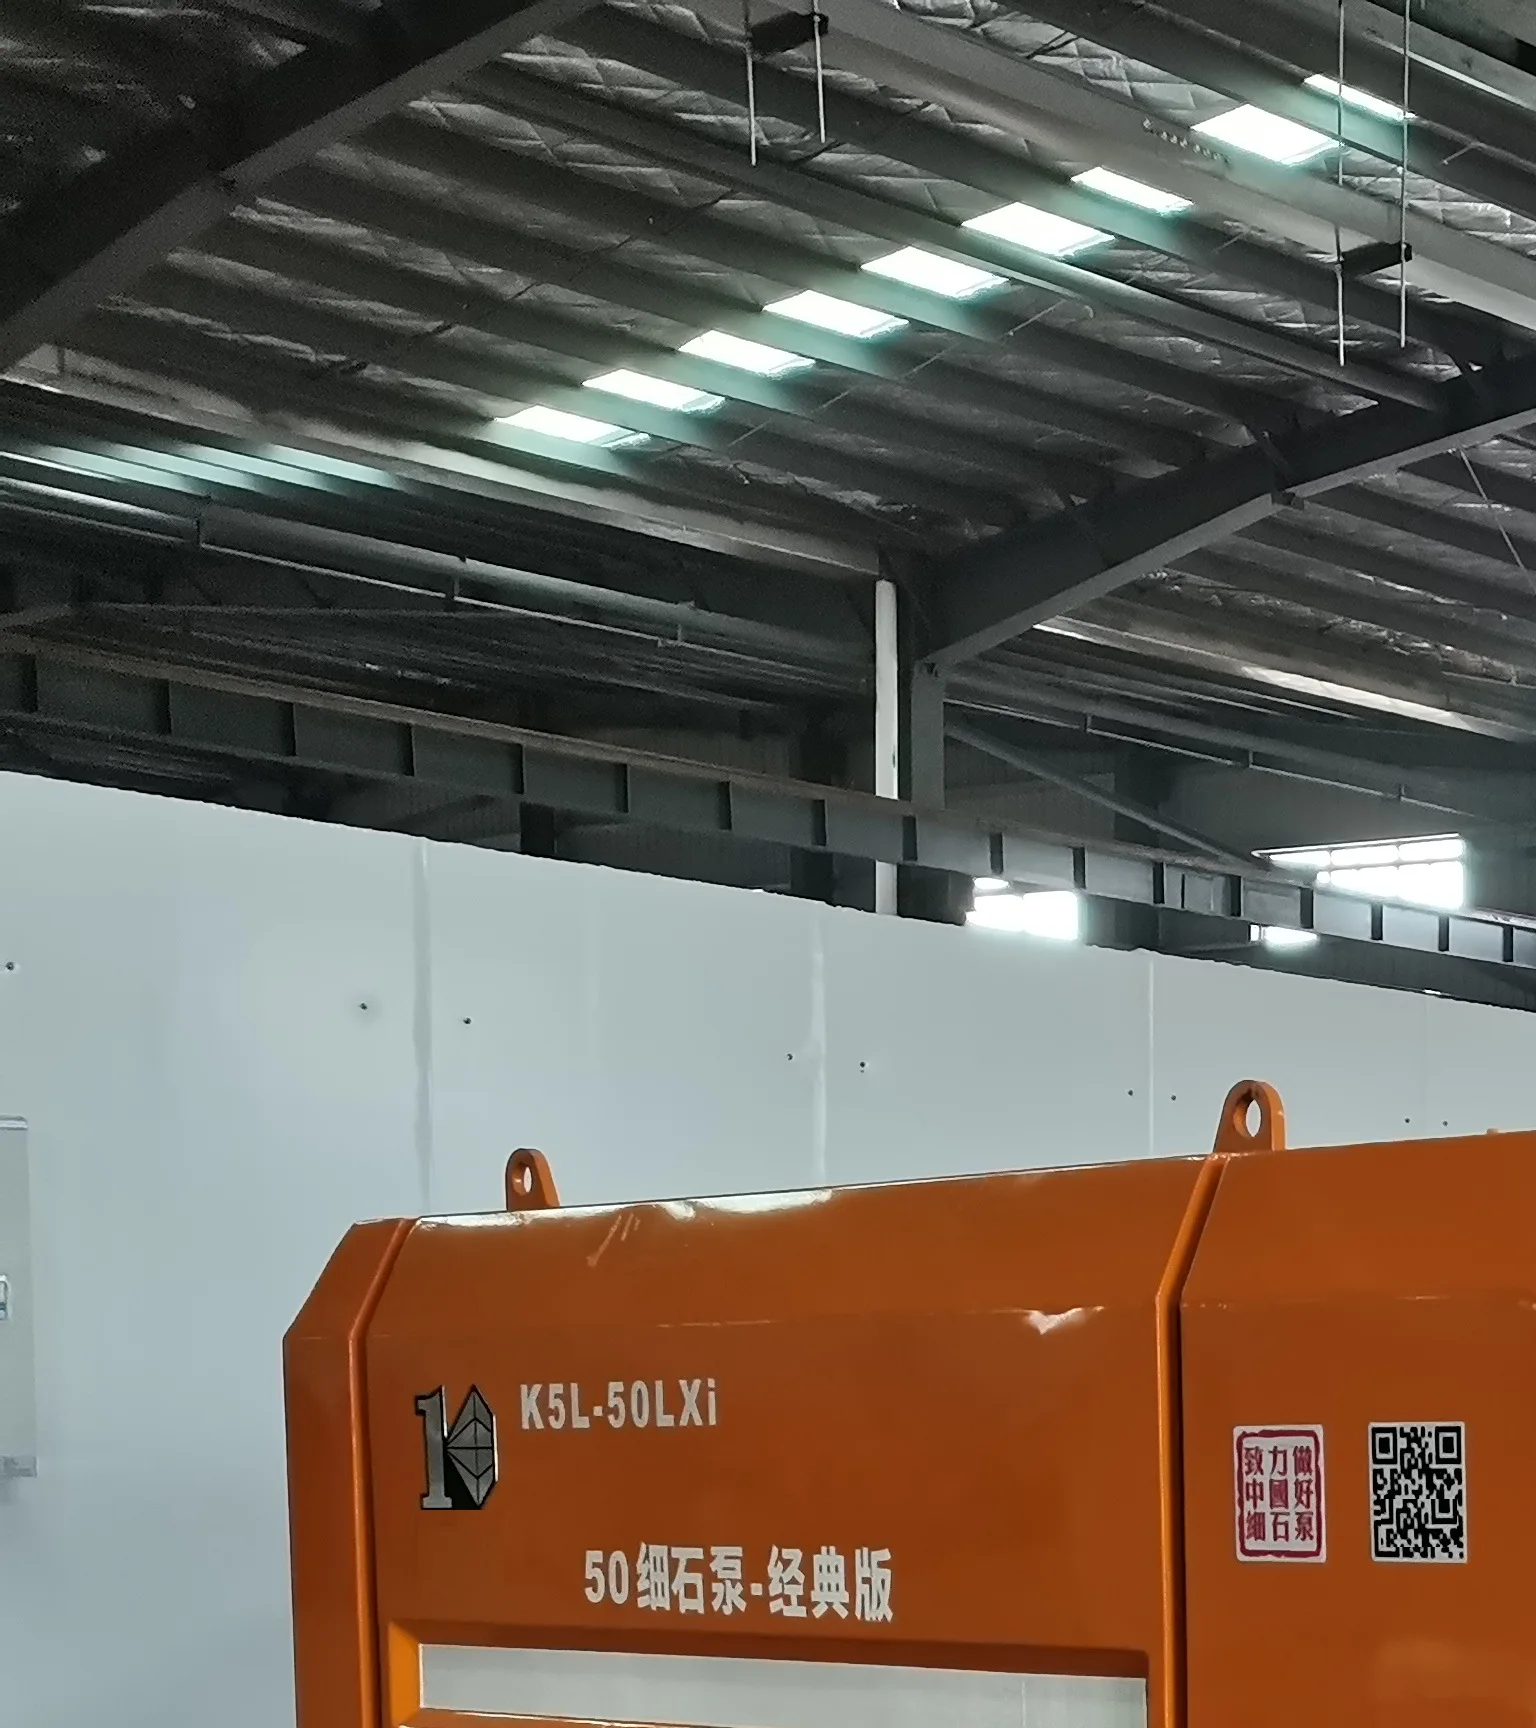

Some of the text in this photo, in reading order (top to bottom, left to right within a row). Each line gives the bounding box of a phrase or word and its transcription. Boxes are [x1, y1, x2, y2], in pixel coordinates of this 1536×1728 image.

[520, 1378, 717, 1430] K5L-50LXi
[1246, 1511, 1314, 1542] 细石泵
